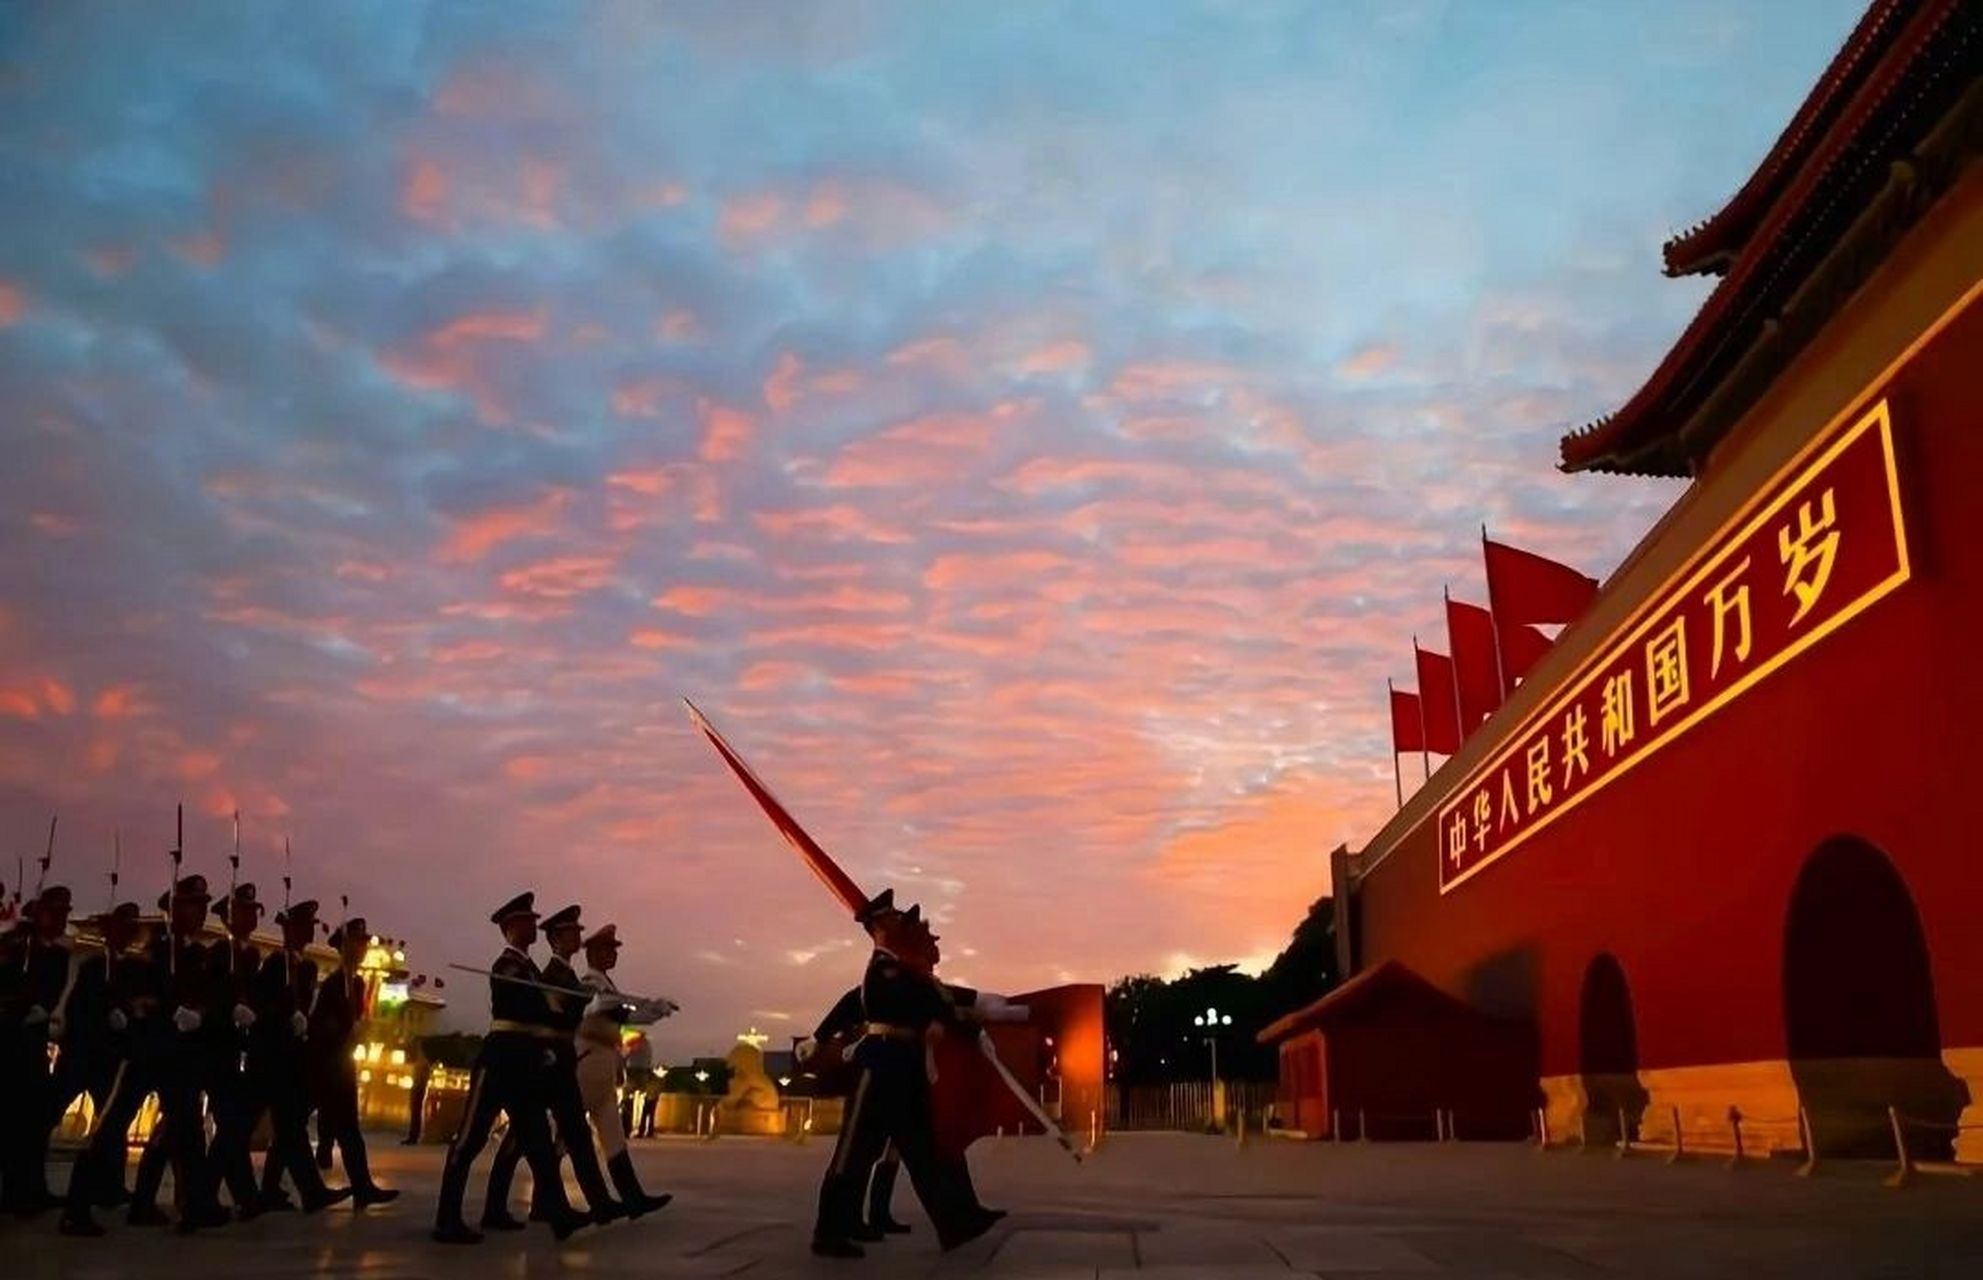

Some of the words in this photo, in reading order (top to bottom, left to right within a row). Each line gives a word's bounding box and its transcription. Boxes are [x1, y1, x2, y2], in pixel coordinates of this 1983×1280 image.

[1448, 487, 1841, 869] 中华人民共和国万岁
